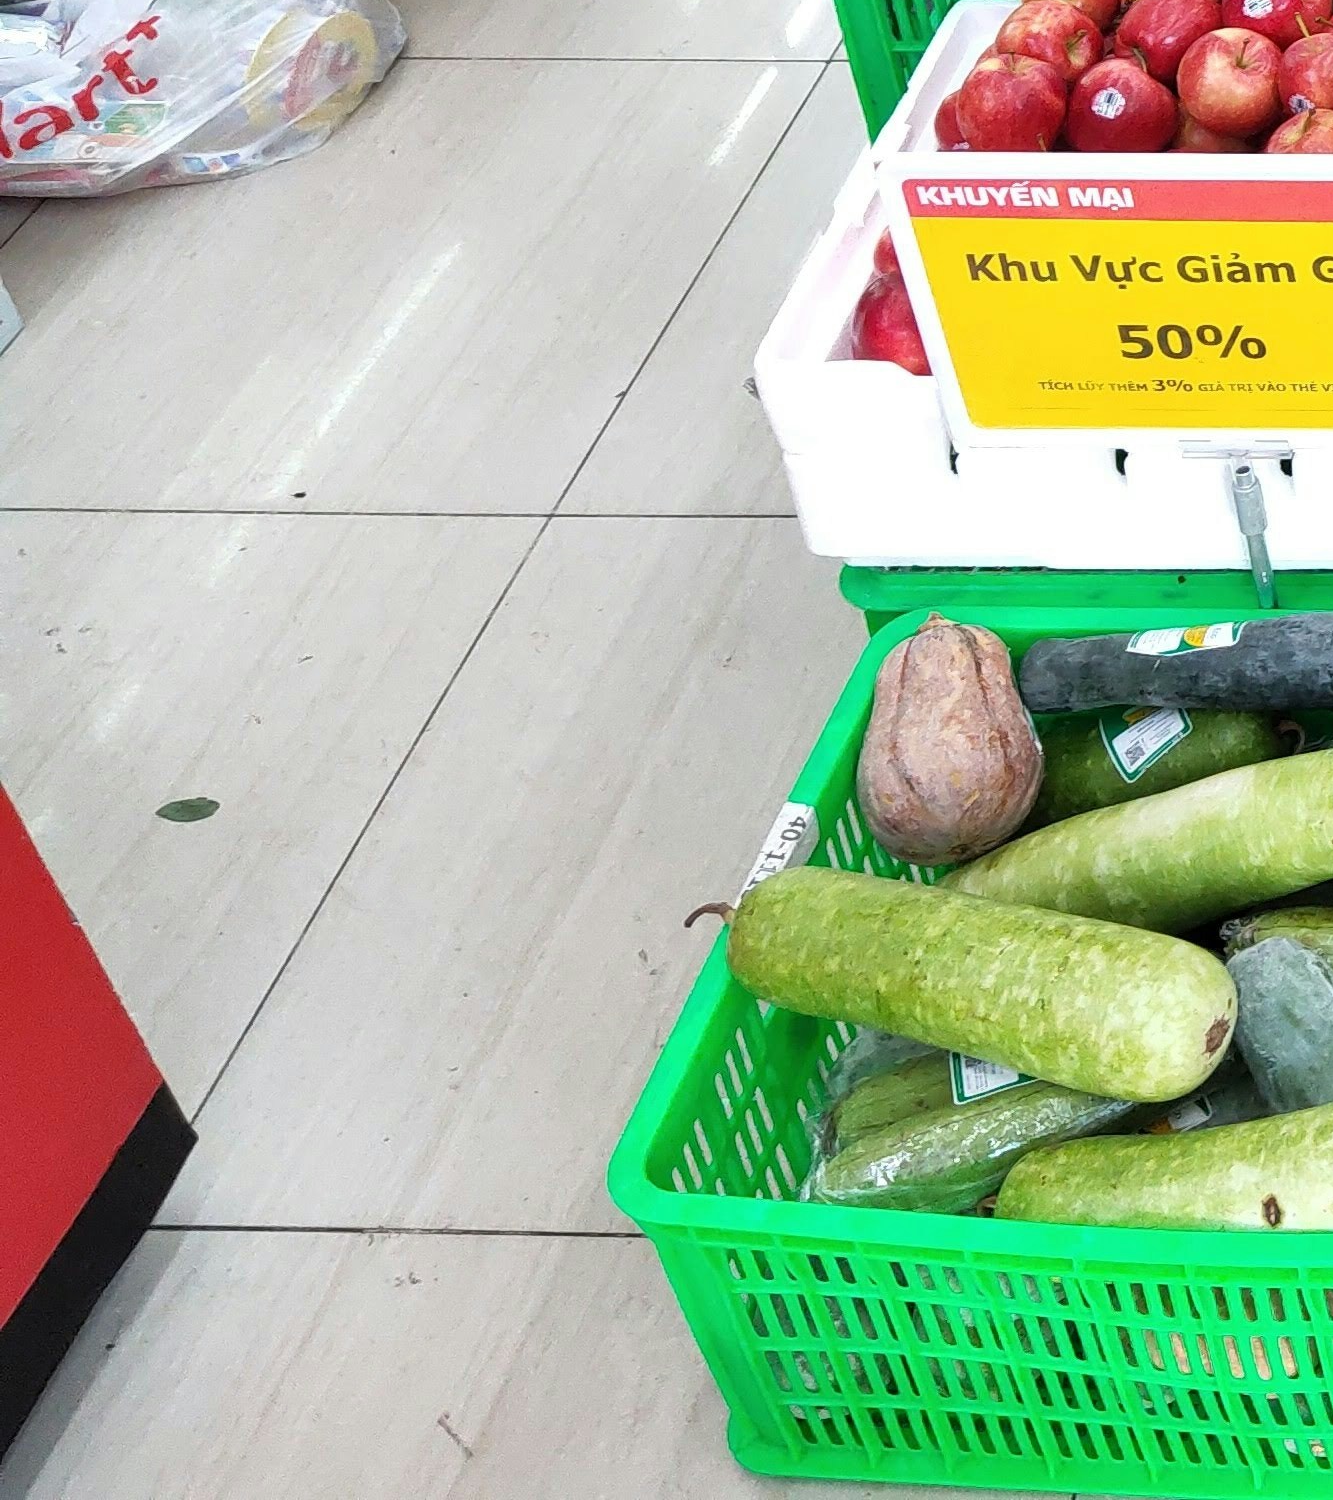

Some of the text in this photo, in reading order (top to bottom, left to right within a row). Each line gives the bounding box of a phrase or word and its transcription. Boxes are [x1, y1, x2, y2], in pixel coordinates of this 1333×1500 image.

[0, 45, 159, 158] art
[915, 180, 1136, 211] KHUYẾN MẠI
[966, 252, 1059, 283] Khu
[1070, 254, 1162, 289] Vực
[1177, 251, 1296, 285] Giảm
[1117, 324, 1268, 360] 50%
[1037, 378, 1074, 392] TÍCH
[1108, 379, 1149, 392] THÊM
[1151, 379, 1194, 393] 3%
[1257, 380, 1287, 393] VÀO
